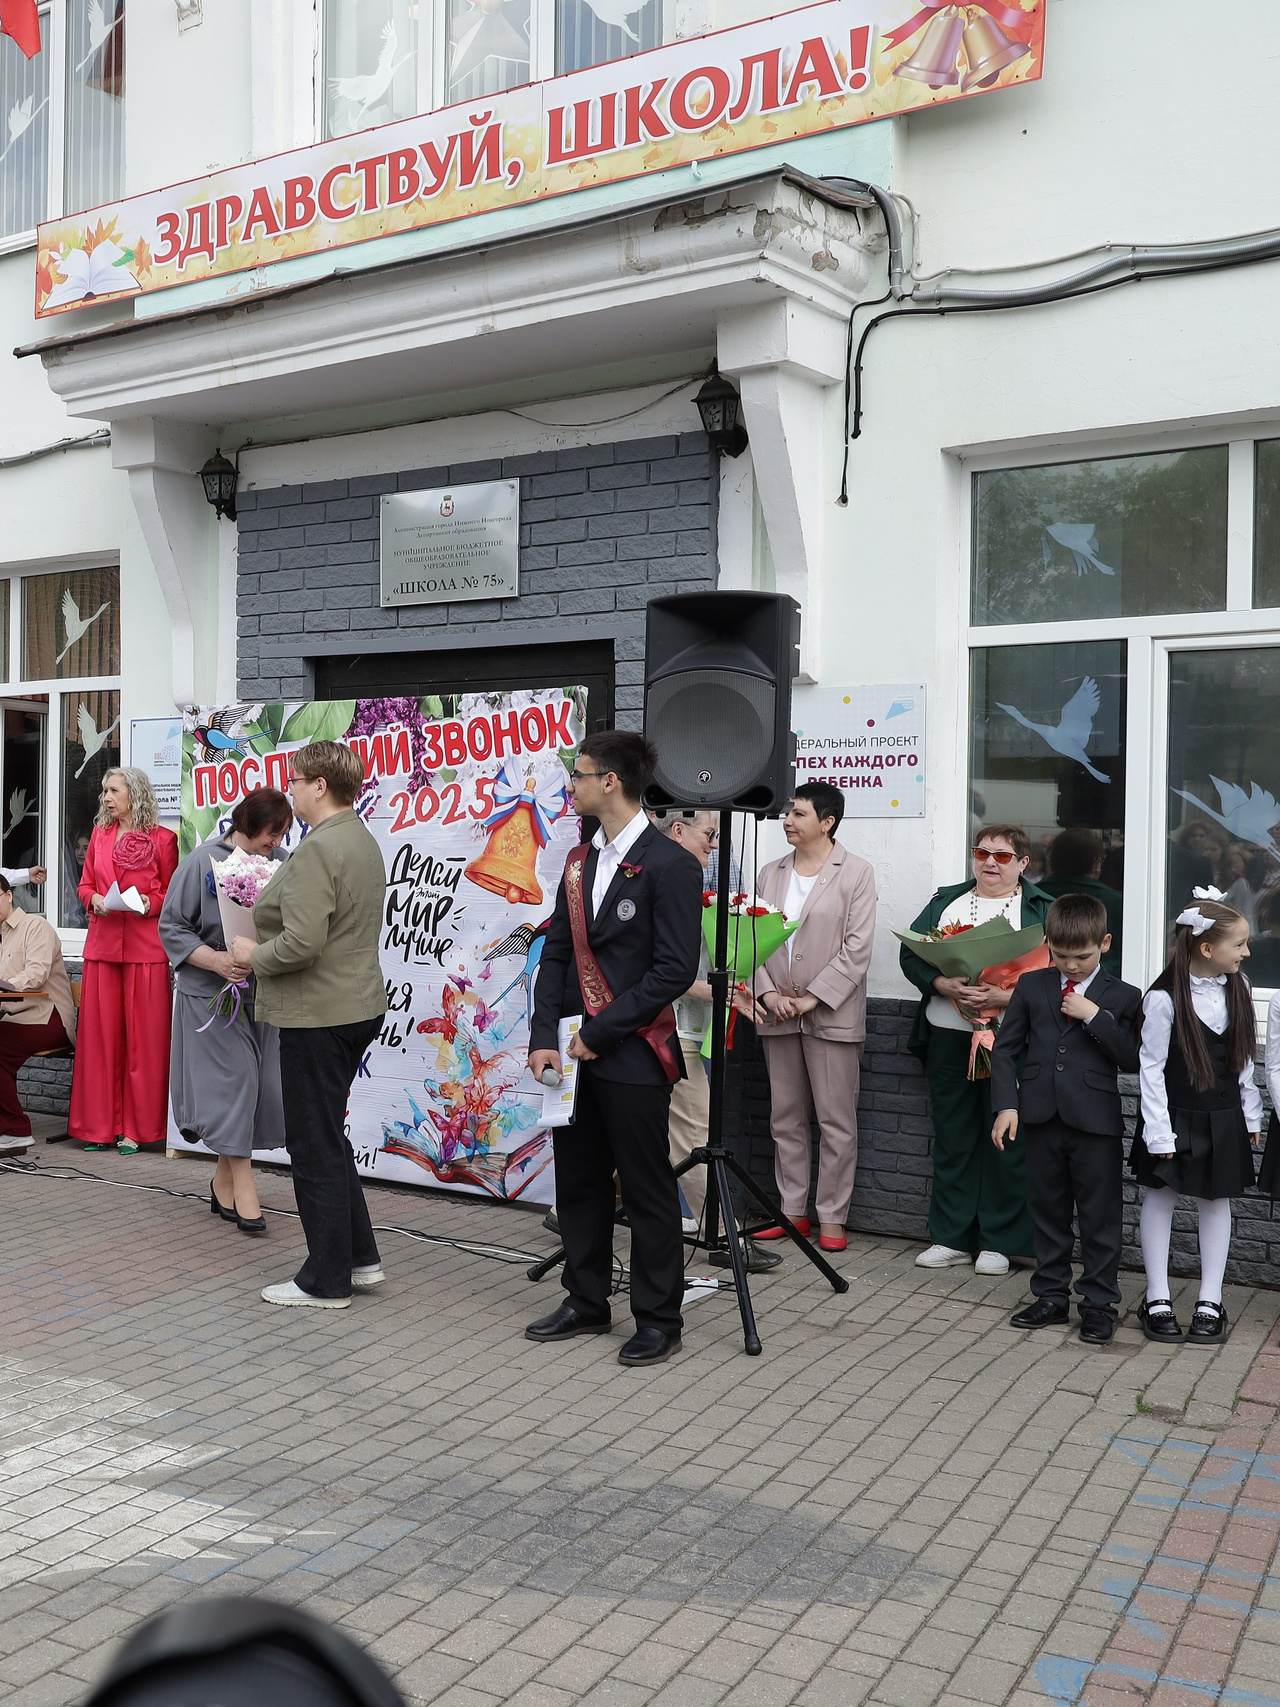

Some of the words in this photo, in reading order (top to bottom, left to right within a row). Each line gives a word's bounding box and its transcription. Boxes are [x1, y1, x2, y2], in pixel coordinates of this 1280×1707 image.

[154, 112, 523, 268] ЗДРАВСТВУЙ,
[546, 24, 872, 164] ШКОЛА!
[393, 544, 455, 557] МУНИЦИПАЛЬНОЕ
[456, 540, 504, 550] БЮДЖЕТНОЕ
[404, 550, 491, 564] ОБЩЕОБРАЗОВАТЕЛЬНОЕ
[423, 560, 471, 571] УЧРЕЖДЕНИЕ
[392, 578, 458, 595] «ШКОЛА
[461, 576, 479, 589] №
[483, 573, 505, 587] 75»
[796, 735, 867, 751] ЕРАЛЬНЫЙ
[870, 735, 919, 748] ПРОЕКТ
[195, 725, 411, 807] ПОСЛИЙ
[423, 701, 574, 769] ЗВОНОК
[796, 756, 827, 769] ПЕХ
[832, 754, 919, 770] КАЖДОГО
[389, 777, 498, 834] 2025
[581, 963, 612, 1008] 2025
